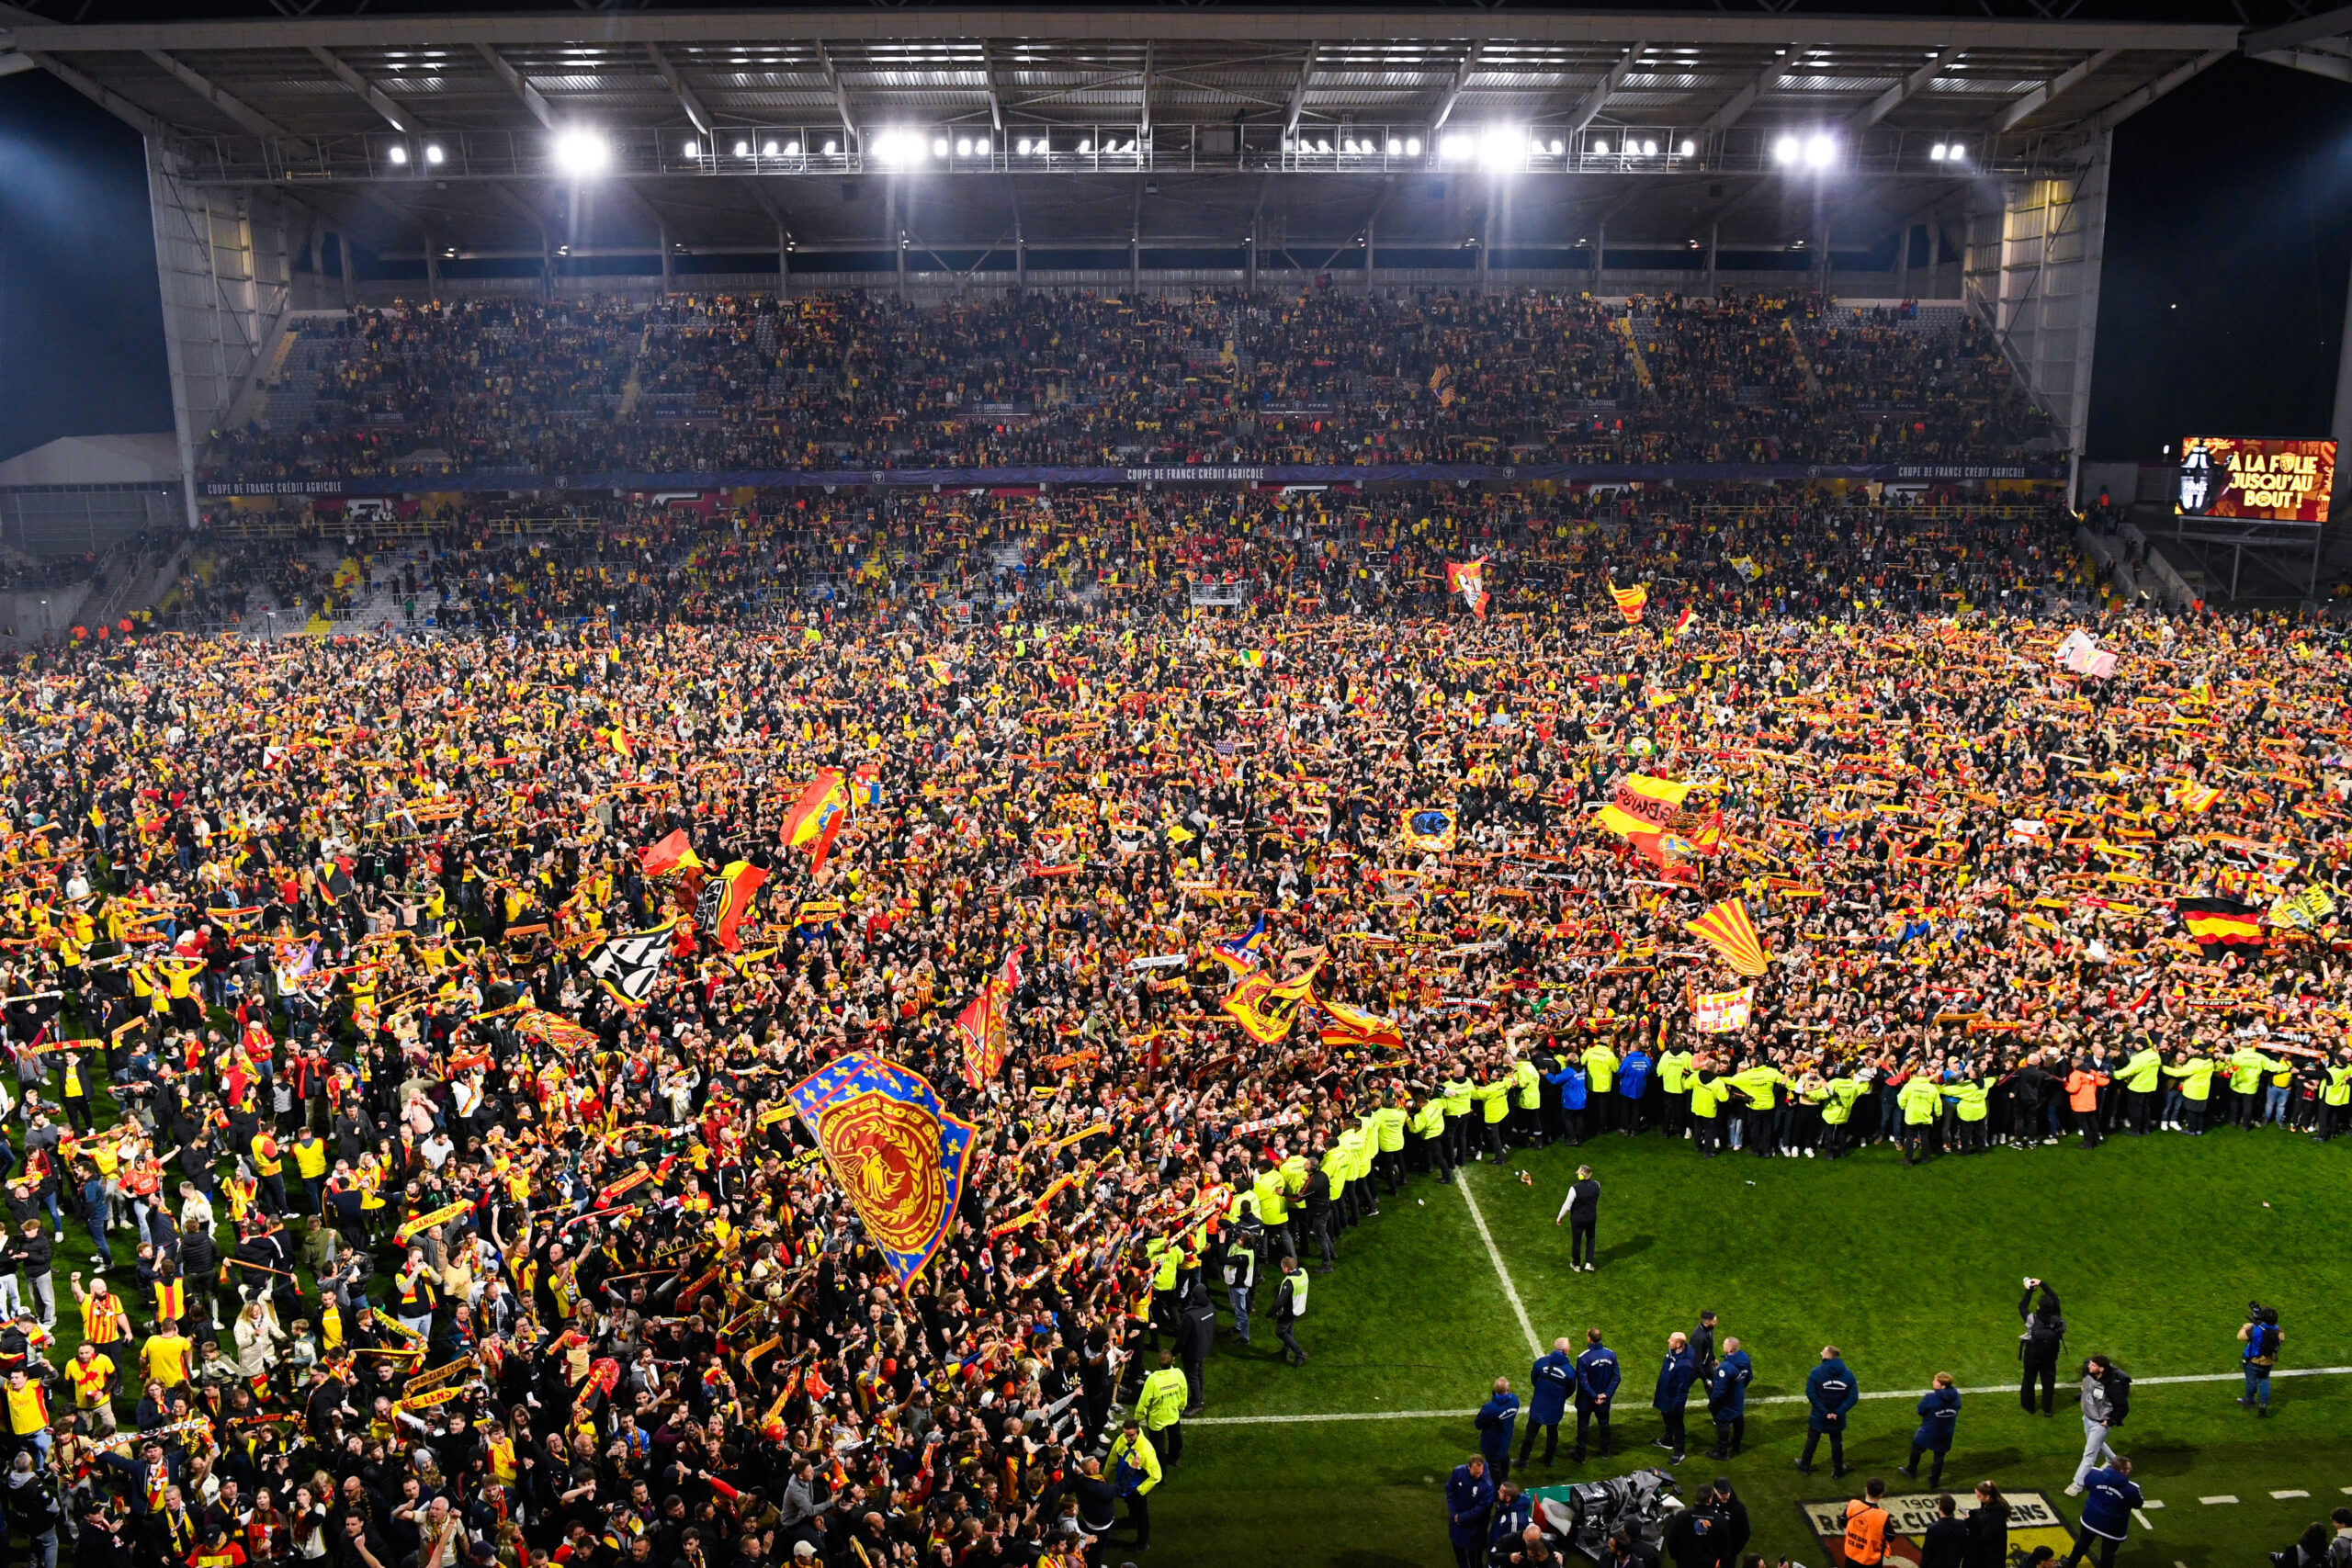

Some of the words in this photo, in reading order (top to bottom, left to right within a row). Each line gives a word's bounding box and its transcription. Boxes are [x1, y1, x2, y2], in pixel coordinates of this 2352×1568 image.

[1898, 467, 1920, 477] COUPE
[1924, 467, 1932, 477] DE
[1935, 467, 1962, 477] FRANCE
[1964, 466, 1989, 477] CRÉDIT
[1992, 467, 2026, 477] AGRICOLE
[2245, 455, 2266, 472] LA
[1127, 468, 1151, 479] COUPE
[1154, 468, 1164, 479] DE
[1167, 468, 1195, 479] FRANCE
[1198, 467, 1225, 479] CRÉDIT
[1227, 468, 1263, 479] AGRICOLE
[208, 484, 231, 494] COUPE
[234, 483, 243, 494] DE
[246, 483, 274, 494] FRANCE
[277, 481, 303, 493] CRÉDIT
[306, 482, 342, 492] AGRICOLE
[2229, 473, 2313, 491] JUSQU'AU
[883, 1102, 924, 1125] 2015
[786, 1157, 801, 1170] RC
[413, 1214, 437, 1230] SANG
[443, 1206, 458, 1217] OR
[902, 1200, 939, 1247] CLUB
[401, 1397, 420, 1409] RC
[425, 1390, 453, 1404] LENS
[1848, 1540, 1865, 1551] CLUB
